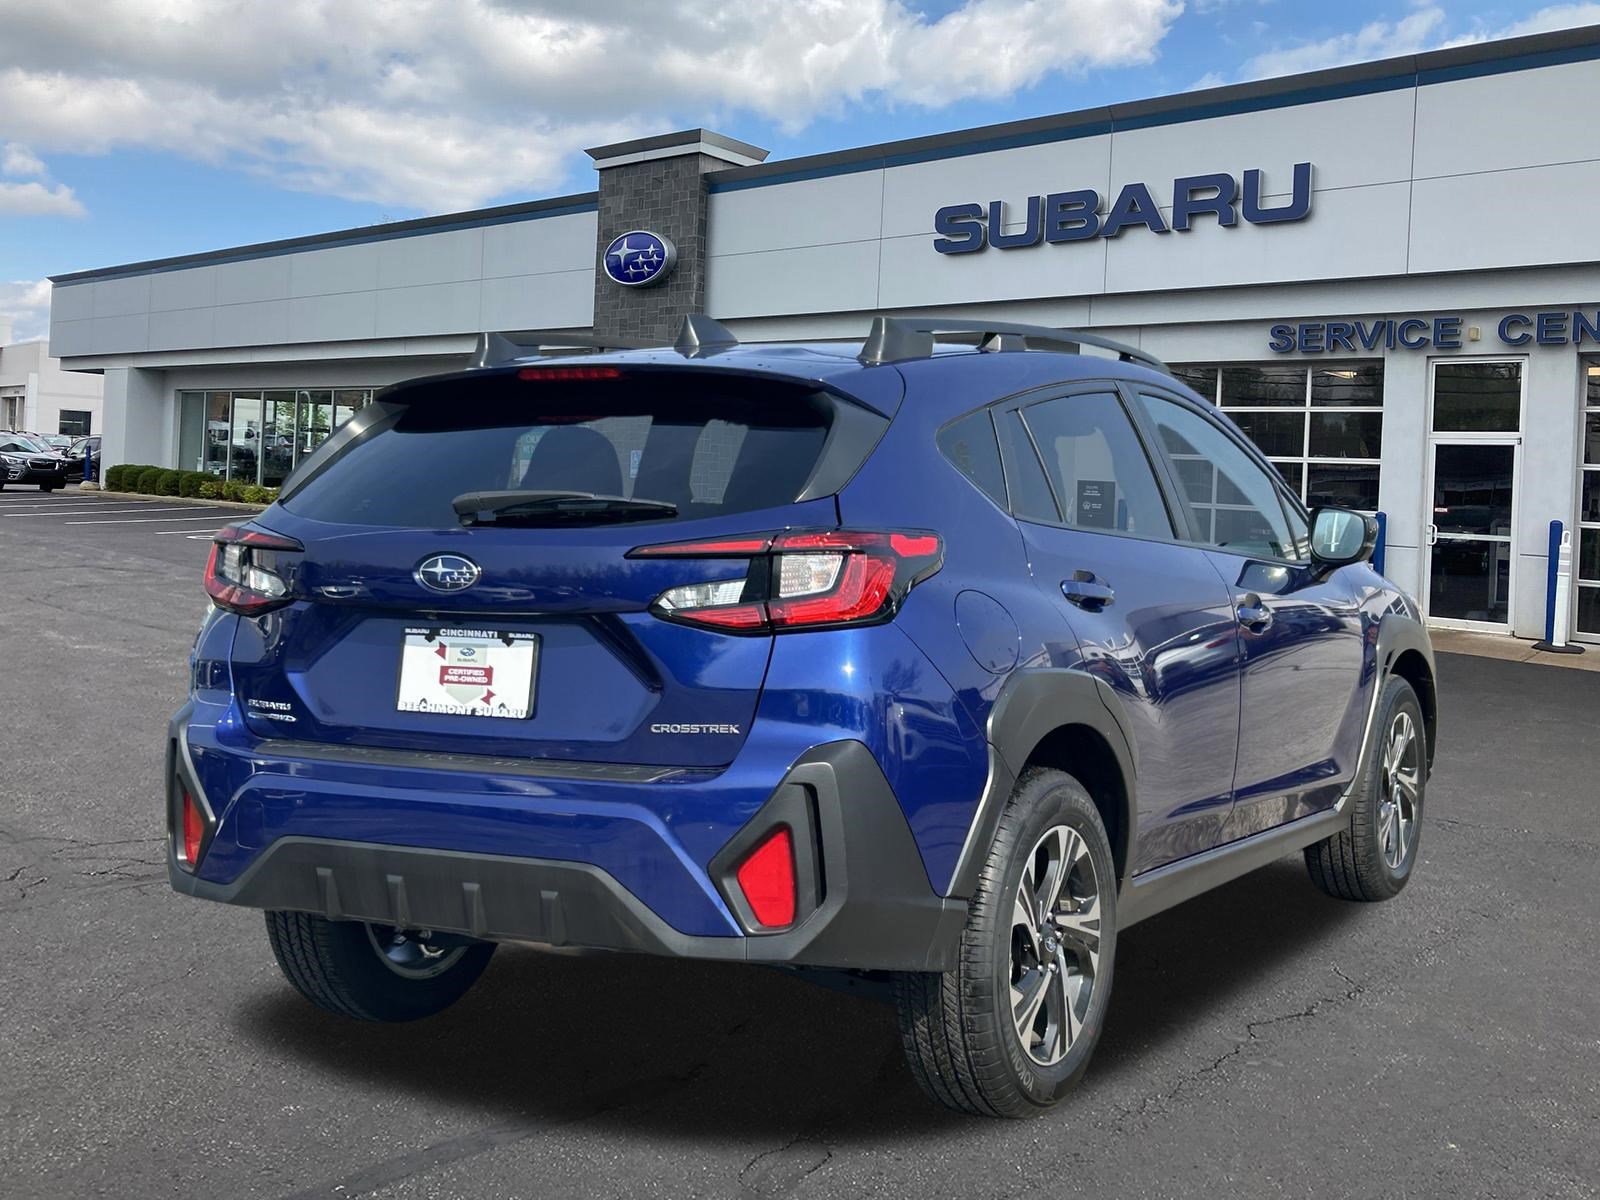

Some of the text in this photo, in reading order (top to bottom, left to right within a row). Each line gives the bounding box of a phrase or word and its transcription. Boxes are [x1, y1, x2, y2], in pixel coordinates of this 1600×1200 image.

[934, 162, 1312, 255] SUBARU
[1269, 310, 1600, 353] SERVICE CEN
[440, 628, 498, 639] CINCINNATI
[448, 668, 485, 677] CERTIFIED
[444, 674, 488, 684] PRE-OWNED
[248, 698, 292, 710] SUBARU
[475, 705, 527, 719] SUBARU
[650, 723, 740, 735] CROSSTREK
